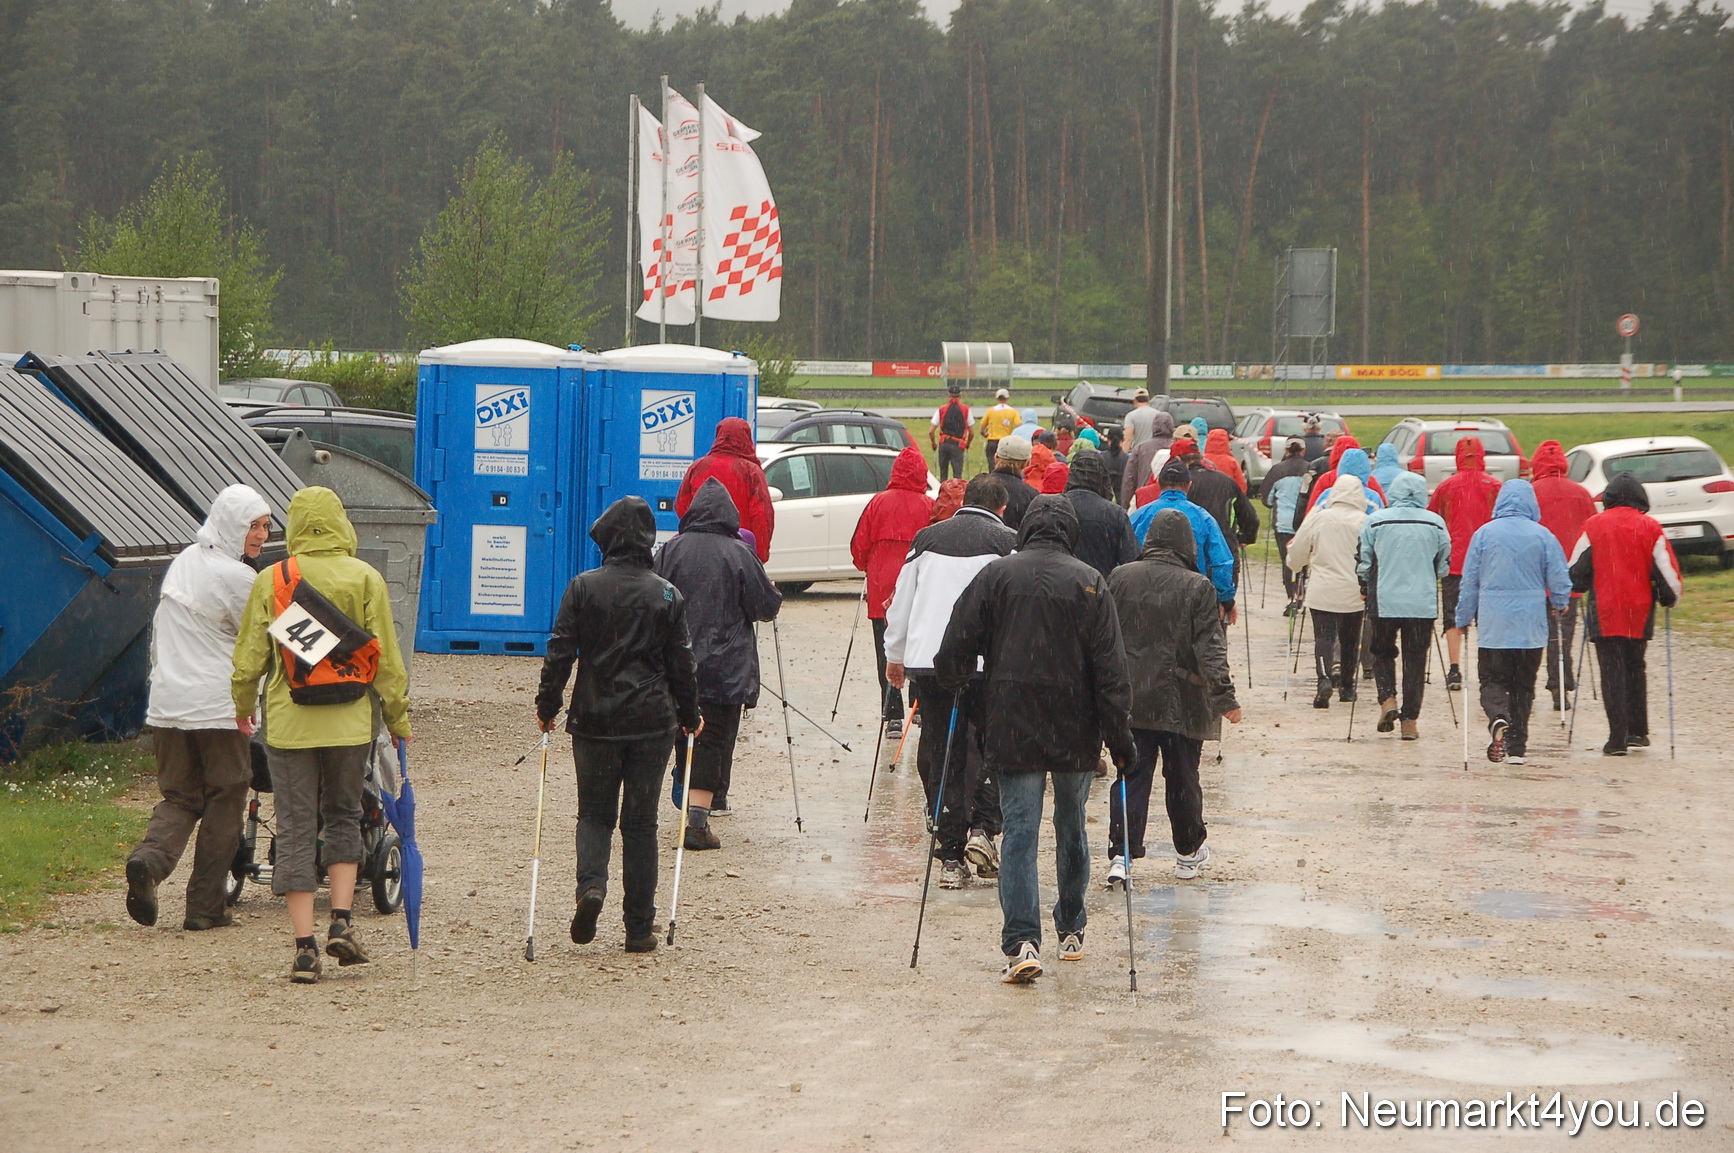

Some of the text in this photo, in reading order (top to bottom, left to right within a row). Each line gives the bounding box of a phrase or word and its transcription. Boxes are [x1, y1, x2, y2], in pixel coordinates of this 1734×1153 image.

[927, 365, 942, 376] GU
[1357, 366, 1422, 377] MAX BÖGL
[285, 617, 326, 653] 44
